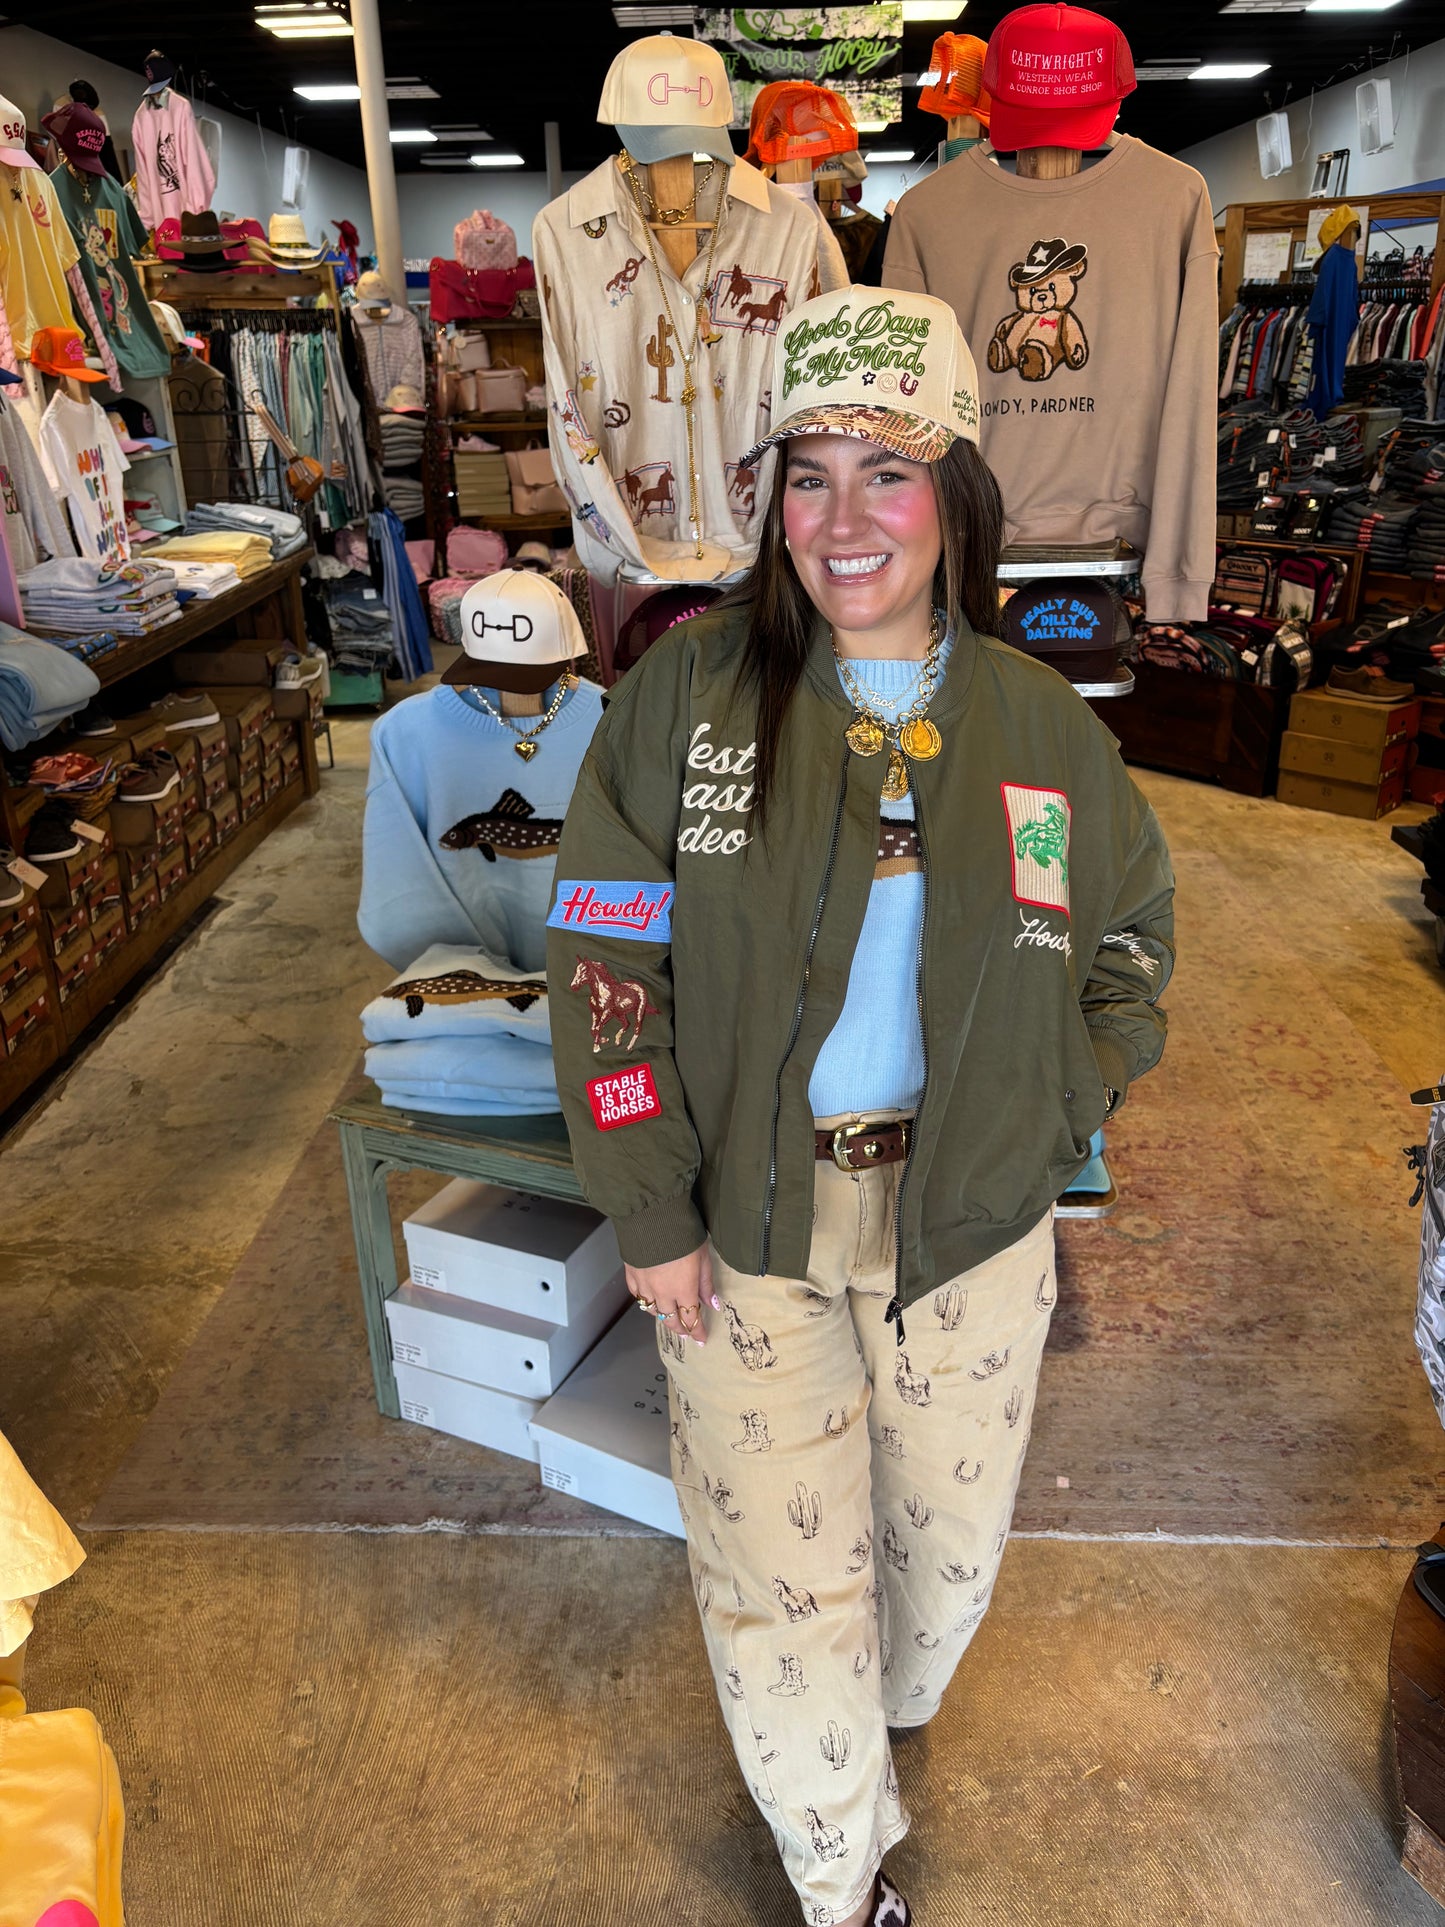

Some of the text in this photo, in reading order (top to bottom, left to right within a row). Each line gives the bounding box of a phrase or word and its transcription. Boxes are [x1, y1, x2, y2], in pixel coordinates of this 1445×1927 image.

[1011, 48, 1103, 70] CARTWRIGHT'S
[1009, 82, 1103, 95] & CONROE SHOE SHOP
[1018, 71, 1093, 83] WESTERN WEAR
[784, 300, 931, 358] Good Days
[803, 346, 848, 388] My
[844, 342, 928, 377] Mind
[1031, 397, 1095, 413] PARDNER
[1020, 598, 1100, 629] REALLY BUSY
[1040, 614, 1080, 626] DILLY
[1026, 626, 1093, 640] DALLYING
[688, 722, 756, 774] est
[677, 814, 753, 855] deo
[562, 886, 671, 932] Howdy!
[594, 1070, 647, 1097] STABLE
[601, 1085, 645, 1109] IS FOR
[600, 1095, 655, 1123] HORSES
